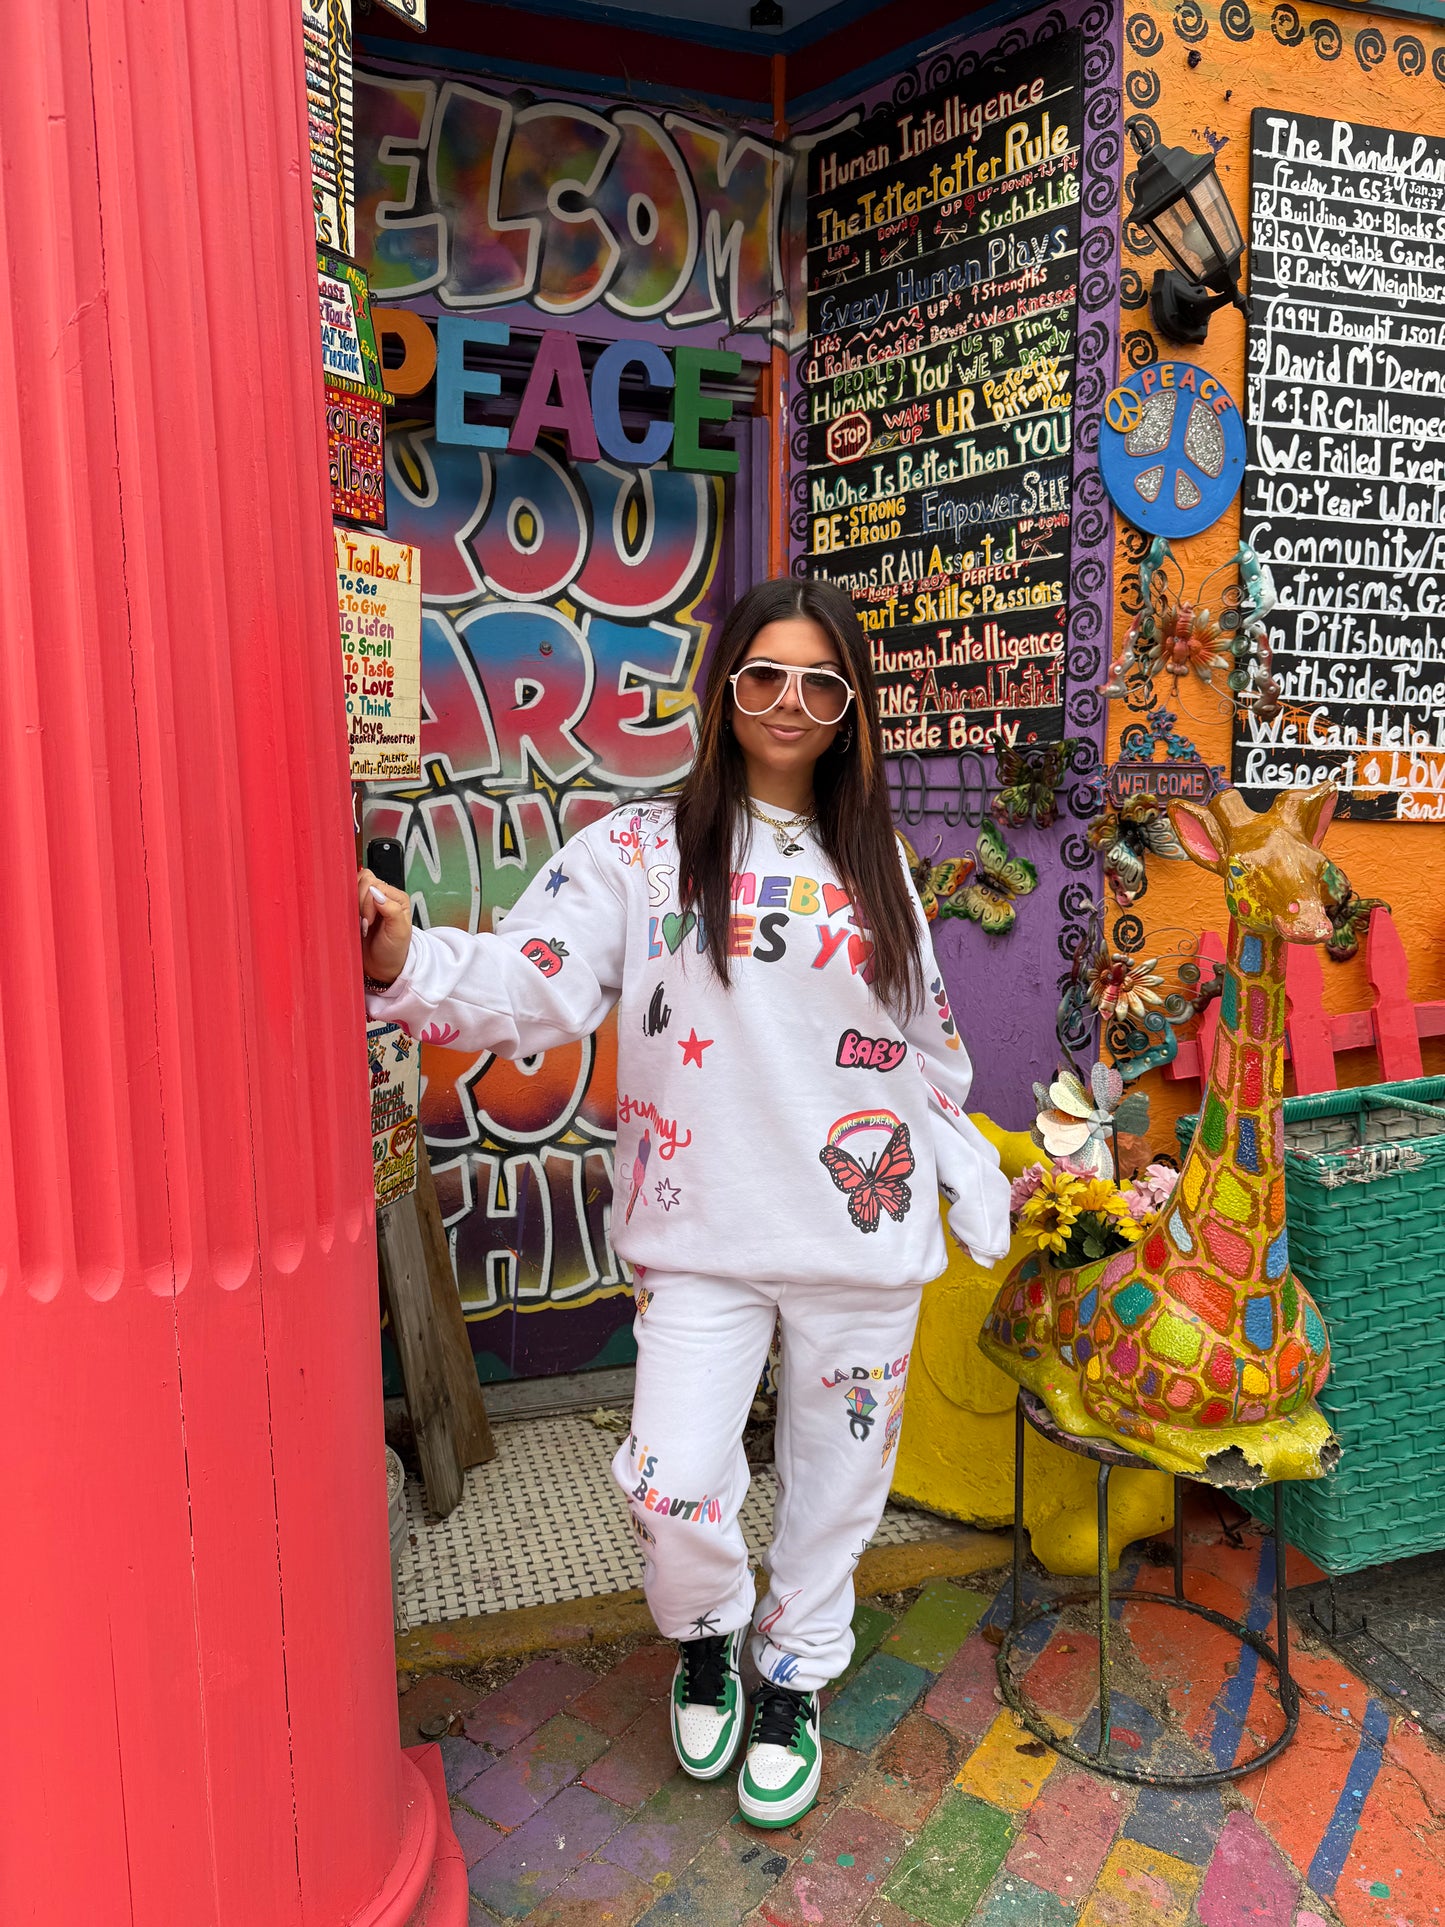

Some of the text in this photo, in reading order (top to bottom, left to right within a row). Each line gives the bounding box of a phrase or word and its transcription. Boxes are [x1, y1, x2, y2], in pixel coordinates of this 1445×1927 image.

[819, 77, 1045, 194] Human Intelligence
[1004, 110, 1069, 174] Rule
[1265, 117, 1323, 161] The
[1279, 167, 1328, 201] Today
[1281, 197, 1347, 237] Building
[1277, 230, 1303, 250] 50
[1304, 226, 1384, 267] Vegetable
[820, 225, 1070, 335] Every Human Plays
[981, 266, 1048, 304] Strengths
[1295, 258, 1339, 289] Parks
[1013, 317, 1053, 345] Fine
[1275, 306, 1319, 337] 1994
[1328, 310, 1394, 349] Bought
[825, 346, 864, 379] Roller
[867, 335, 924, 365] Coaster
[957, 326, 1071, 385] WE Dandy
[1275, 344, 1341, 383] David
[371, 306, 743, 475] PEACE
[833, 361, 895, 398] PEOPLE
[1141, 364, 1233, 416] PEACE
[834, 424, 866, 449] STOP
[900, 425, 924, 445] UP
[1262, 433, 1313, 472] We
[1318, 436, 1382, 476] Failed
[897, 449, 959, 496] Better
[953, 437, 1010, 475] Then
[850, 519, 902, 547] PROUD
[927, 527, 1018, 578] Assorted
[339, 575, 378, 596] To See
[911, 582, 974, 625] Skills
[982, 577, 1064, 615] Passions
[340, 613, 394, 639] To Listen
[346, 595, 387, 618] To Give
[341, 634, 392, 658] To Smell
[869, 638, 936, 674] Human
[345, 655, 395, 678] To Taste
[345, 675, 394, 698] To LOVE
[368, 601, 701, 796] ARE
[352, 715, 384, 735] Move
[359, 695, 392, 718] Think
[1307, 706, 1359, 748] Can
[1367, 708, 1430, 764] Help
[1117, 773, 1205, 797] WELCOME
[1245, 749, 1358, 790] Respect
[836, 1029, 908, 1073] BABY
[617, 1093, 692, 1161] yummy
[821, 1369, 850, 1388] LA
